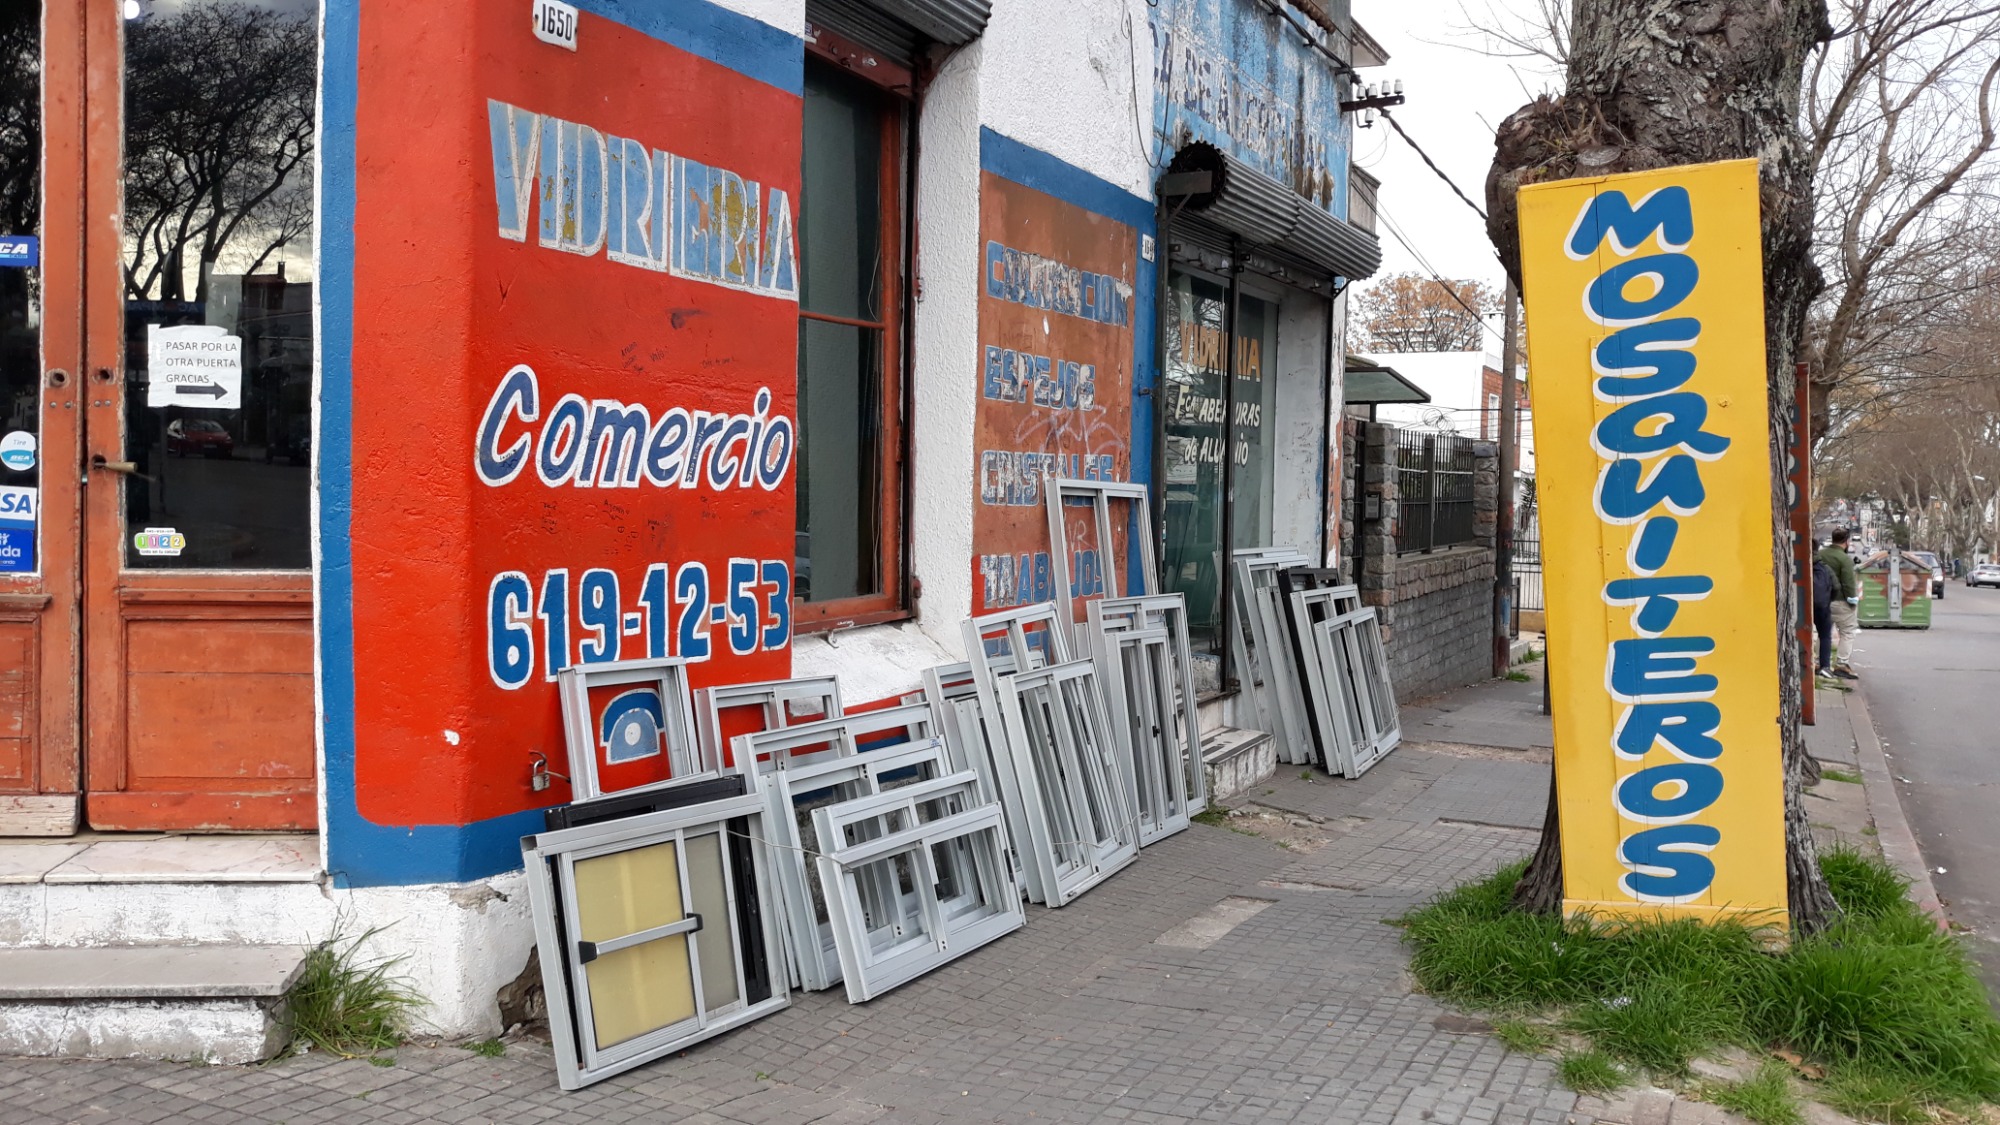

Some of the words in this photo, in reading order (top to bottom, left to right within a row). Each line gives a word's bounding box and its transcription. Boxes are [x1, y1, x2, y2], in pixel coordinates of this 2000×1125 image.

[542, 3, 573, 42] 1650
[166, 341, 198, 351] PASAR
[201, 342, 222, 352] POR
[225, 343, 237, 351] LA
[166, 357, 194, 366] OTRA
[197, 358, 237, 367] PUERTA
[166, 373, 210, 383] GRACIAS
[983, 344, 1096, 411] ESPEJOS
[474, 364, 793, 491] Comercio
[1185, 435, 1198, 462] de
[140, 536, 181, 547] 1122
[1563, 185, 1731, 904] MOSQUITEROS
[487, 557, 791, 690] 619-12-53
